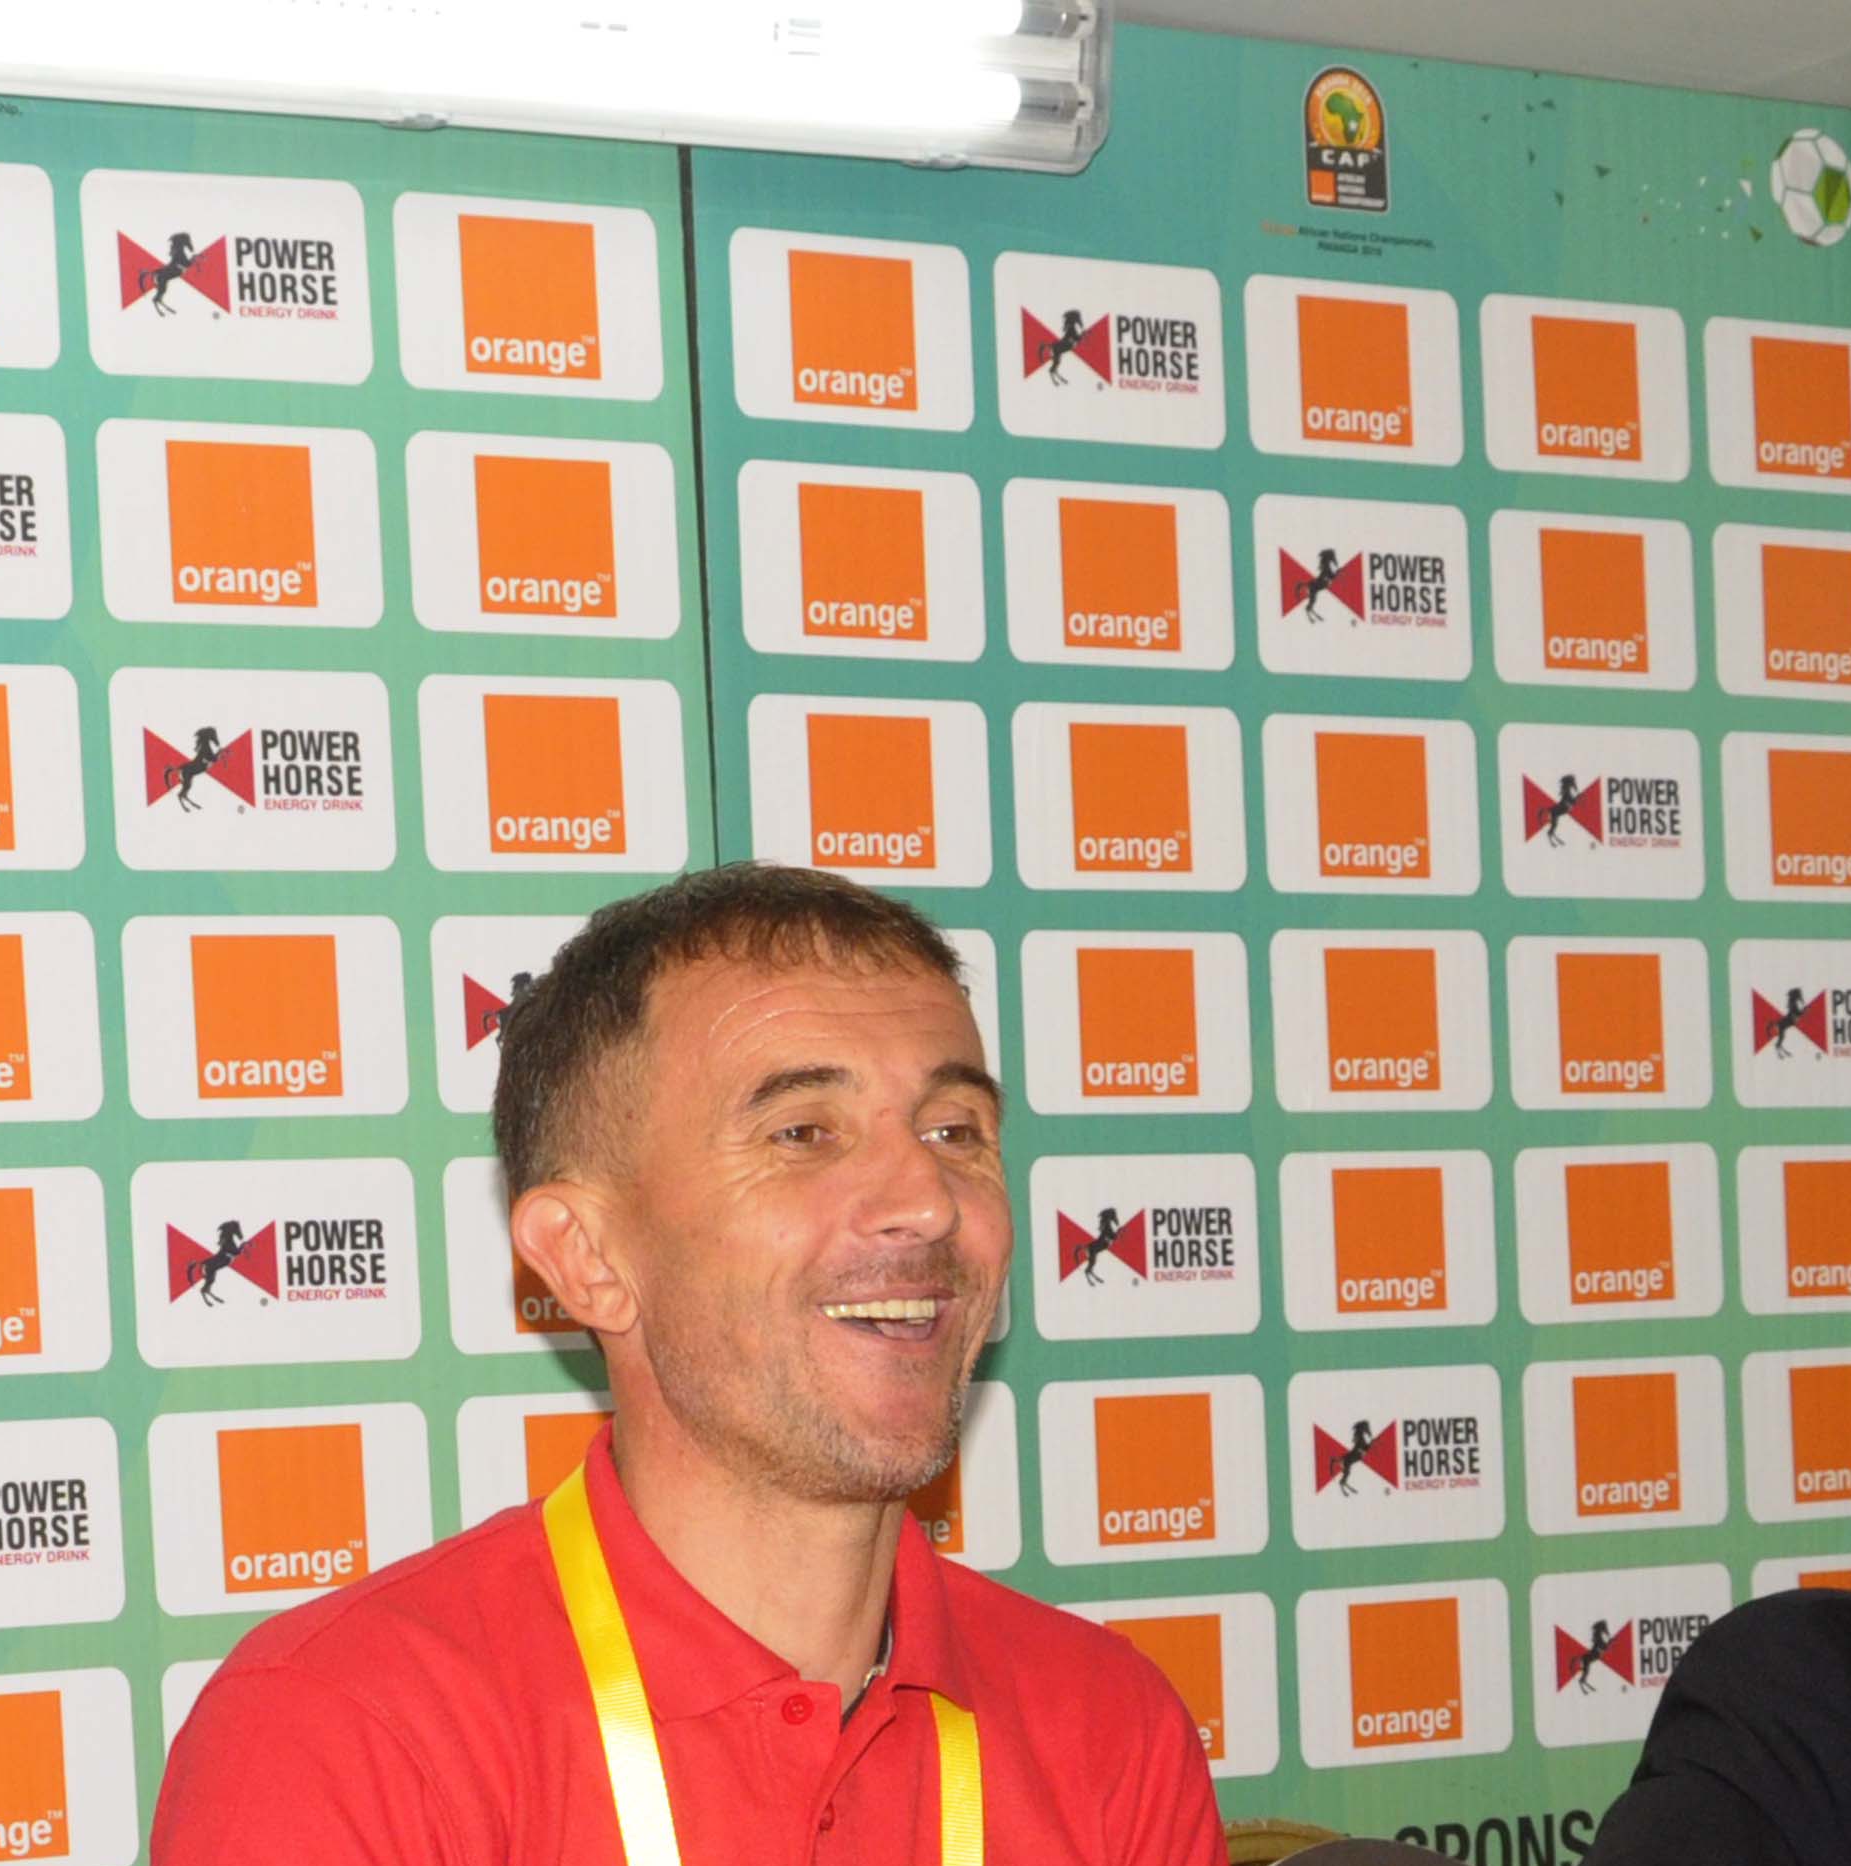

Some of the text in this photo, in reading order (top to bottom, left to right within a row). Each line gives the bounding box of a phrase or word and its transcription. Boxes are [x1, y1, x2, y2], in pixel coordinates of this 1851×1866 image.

[236, 238, 334, 270] POWER
[238, 272, 337, 305] HORSE
[1117, 316, 1196, 348] POWER
[1119, 348, 1198, 380] HORSE
[1370, 554, 1444, 584] POWER
[1371, 584, 1446, 614] HORSE
[262, 730, 360, 761] POWER
[263, 764, 362, 796] HORSE
[1608, 778, 1678, 805] POWER
[1609, 808, 1680, 835] HORSE
[285, 1220, 383, 1251] POWER
[1153, 1208, 1232, 1237] POWER
[1154, 1238, 1233, 1268] HORSE
[287, 1254, 386, 1286] HORSE
[1156, 1272, 1190, 1280] ENERGY
[288, 1288, 384, 1300] ENERGY DRINK
[1403, 1417, 1478, 1446] POWER
[1404, 1447, 1479, 1477] HORSE
[50, 1552, 88, 1562] DRINK
